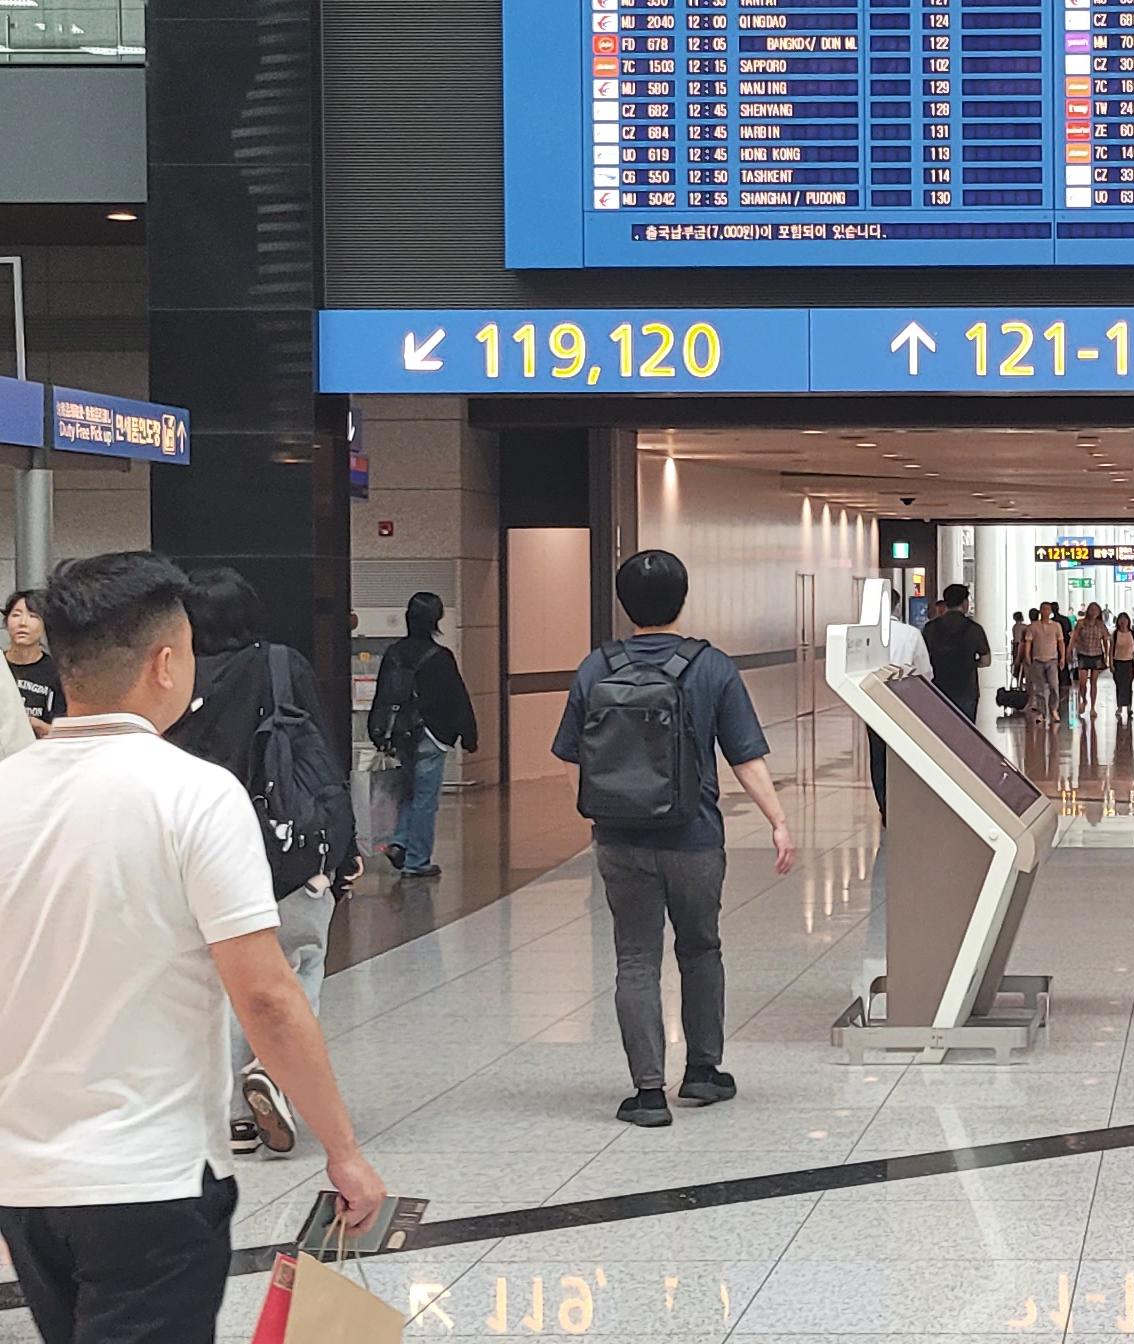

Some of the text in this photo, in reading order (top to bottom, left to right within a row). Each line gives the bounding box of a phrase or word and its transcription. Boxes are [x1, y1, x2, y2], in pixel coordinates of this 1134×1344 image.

[739, 15, 787, 29] QINGDAO
[930, 14, 949, 28] 124
[820, 36, 842, 50] DON
[930, 36, 950, 50] 122
[739, 59, 787, 73] SAPPORO
[930, 58, 950, 72] 102
[739, 81, 787, 95] NANJING
[930, 80, 950, 94] 129
[740, 103, 793, 117] SHENYANG
[930, 102, 950, 116] 128
[740, 125, 780, 139] HARBIN
[931, 125, 949, 138] 131
[740, 147, 801, 161] HONG KONG
[931, 147, 950, 161] 113
[741, 169, 793, 183] TASHKENT
[931, 169, 950, 183] 114
[740, 191, 846, 205] SHANGHAI/ PUDONG
[931, 191, 951, 205] 130
[475, 321, 722, 386] 119,120
[60, 421, 75, 442] Duty
[76, 422, 90, 441] Free
[90, 424, 103, 442] Pick
